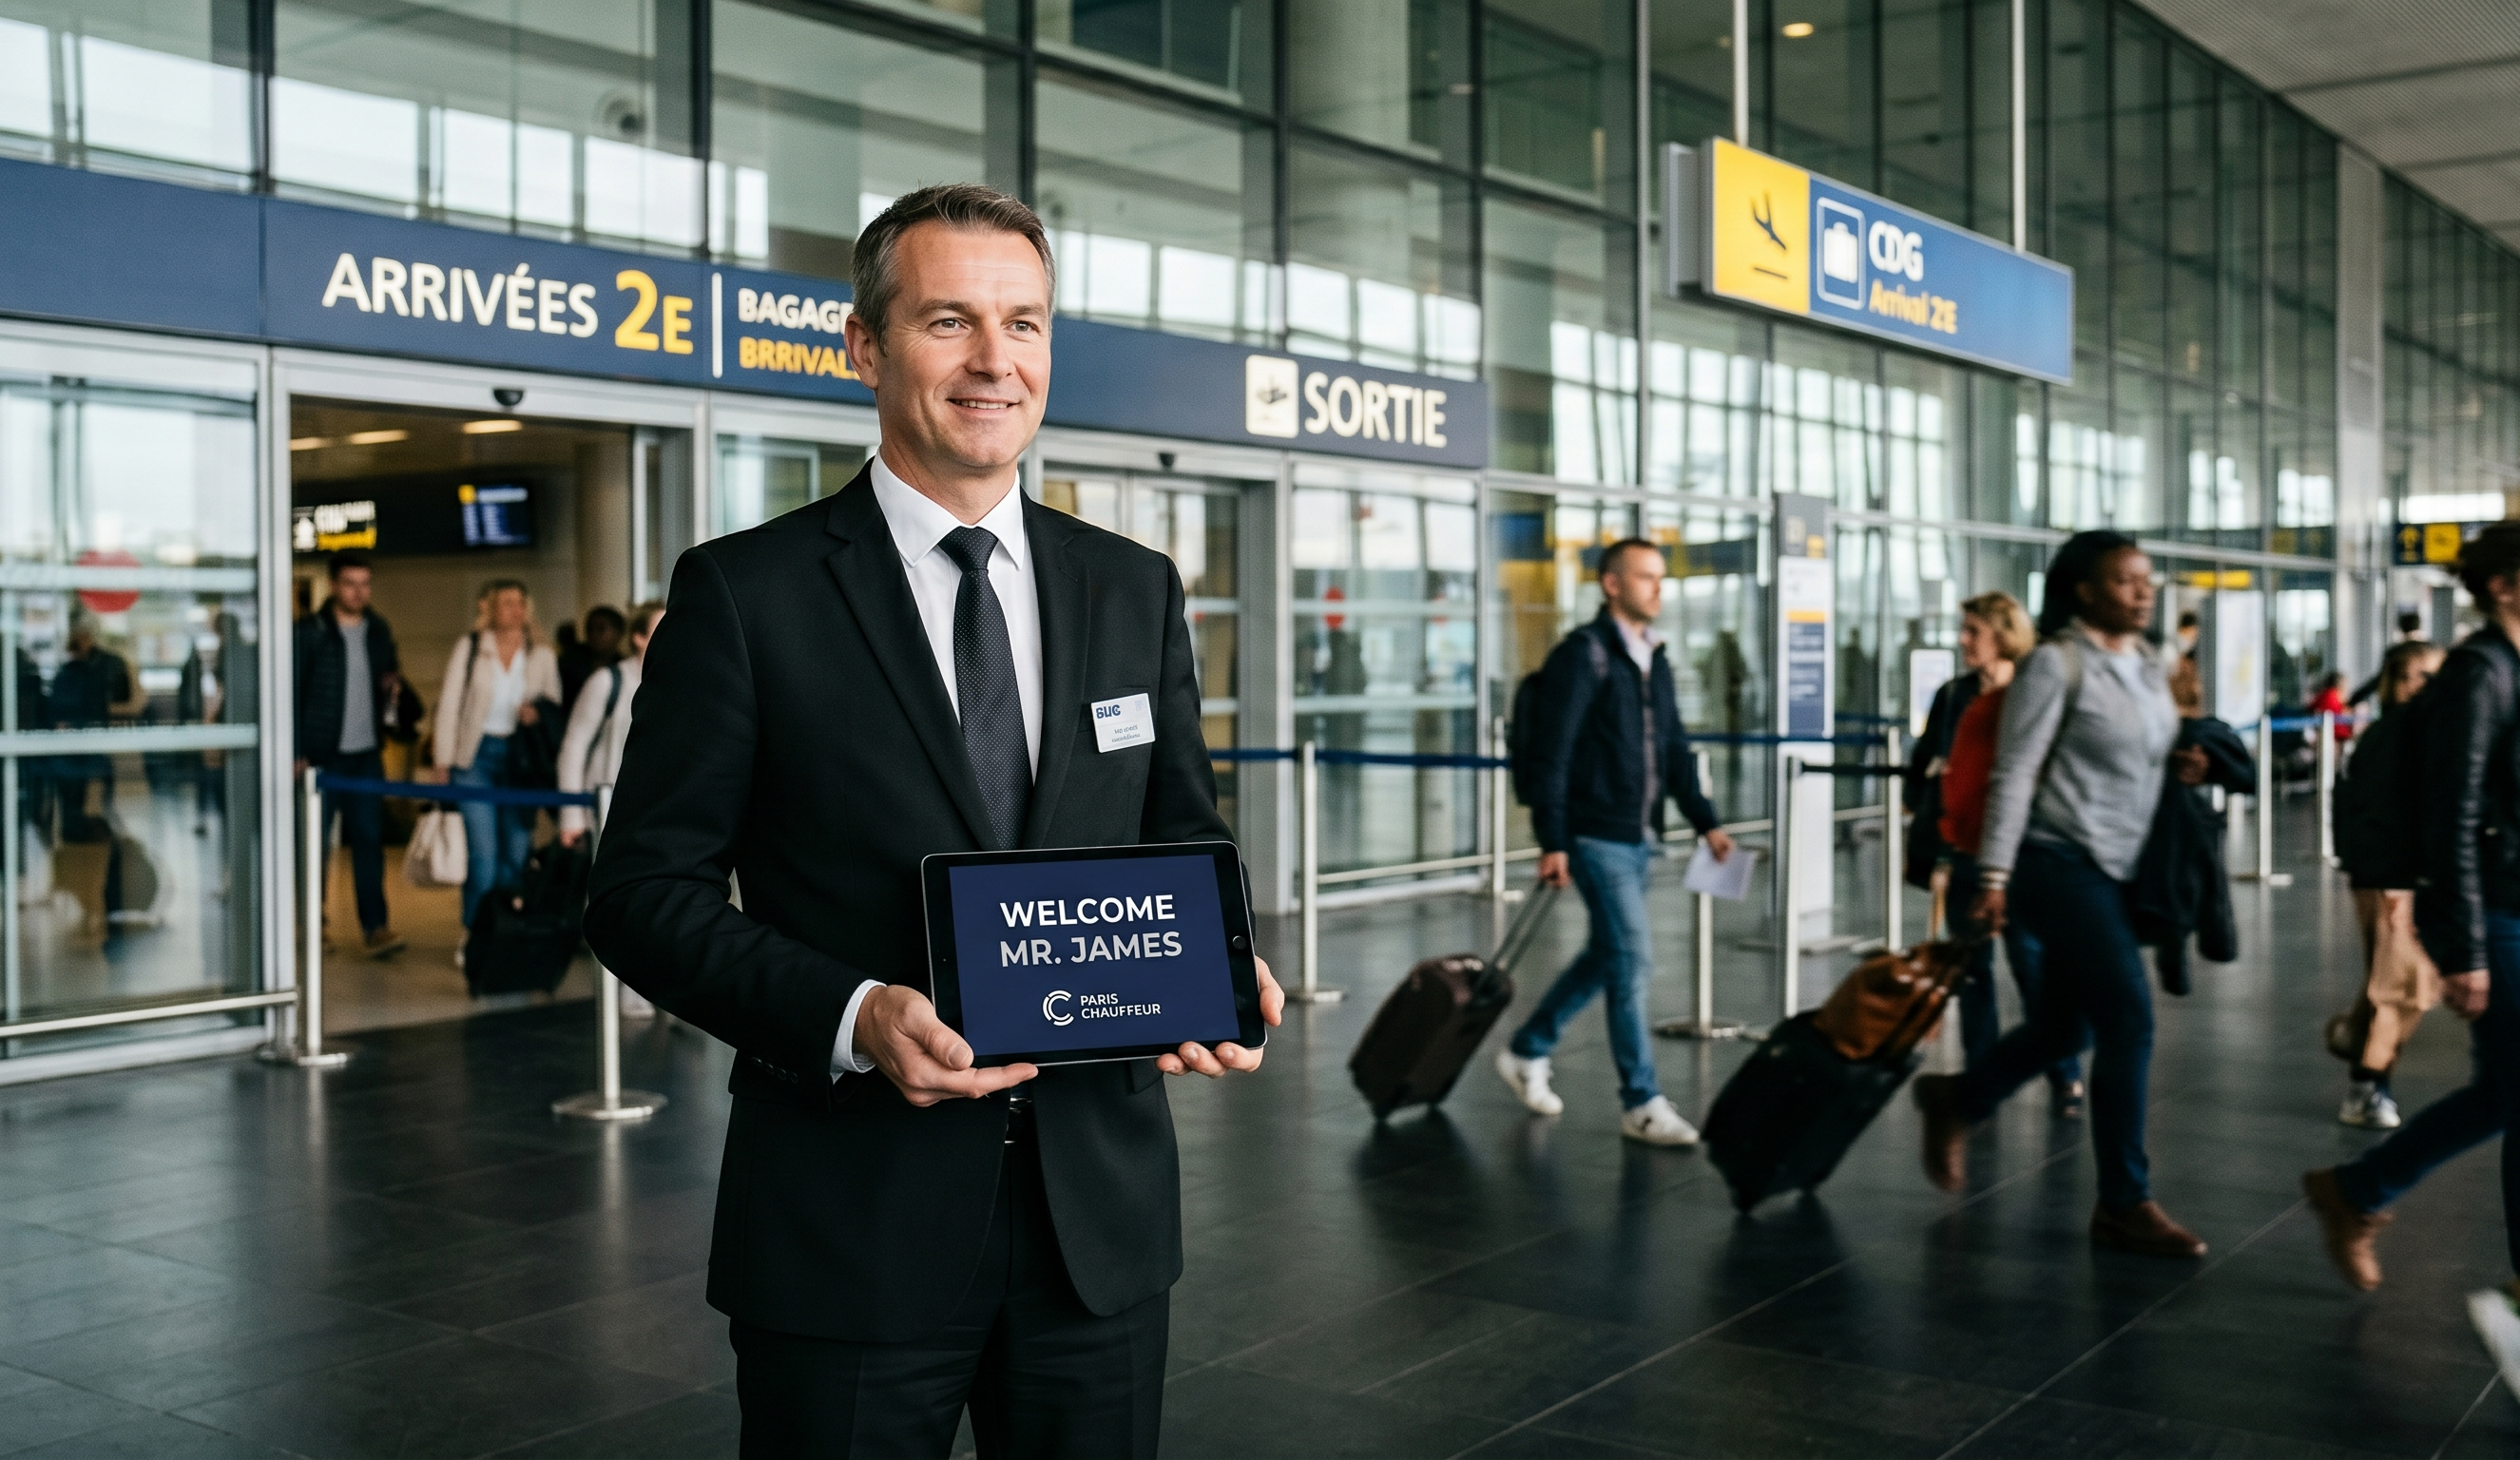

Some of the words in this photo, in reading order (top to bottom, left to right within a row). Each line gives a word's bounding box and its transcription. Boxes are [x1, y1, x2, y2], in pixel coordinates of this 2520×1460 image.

[1869, 221, 1923, 281] CDG
[321, 252, 599, 338] ARRIVÉES
[614, 269, 694, 355] 2E
[1869, 279, 1929, 326] Arrival
[739, 336, 861, 381] BRRIVAL
[1304, 371, 1447, 448] SORTIE
[1000, 894, 1176, 928] WELCOME
[1000, 938, 1062, 968] MR.
[1070, 931, 1183, 964] JAMES
[1080, 993, 1119, 1007] PARIS
[1081, 1003, 1162, 1019] CHAUFFEUR
